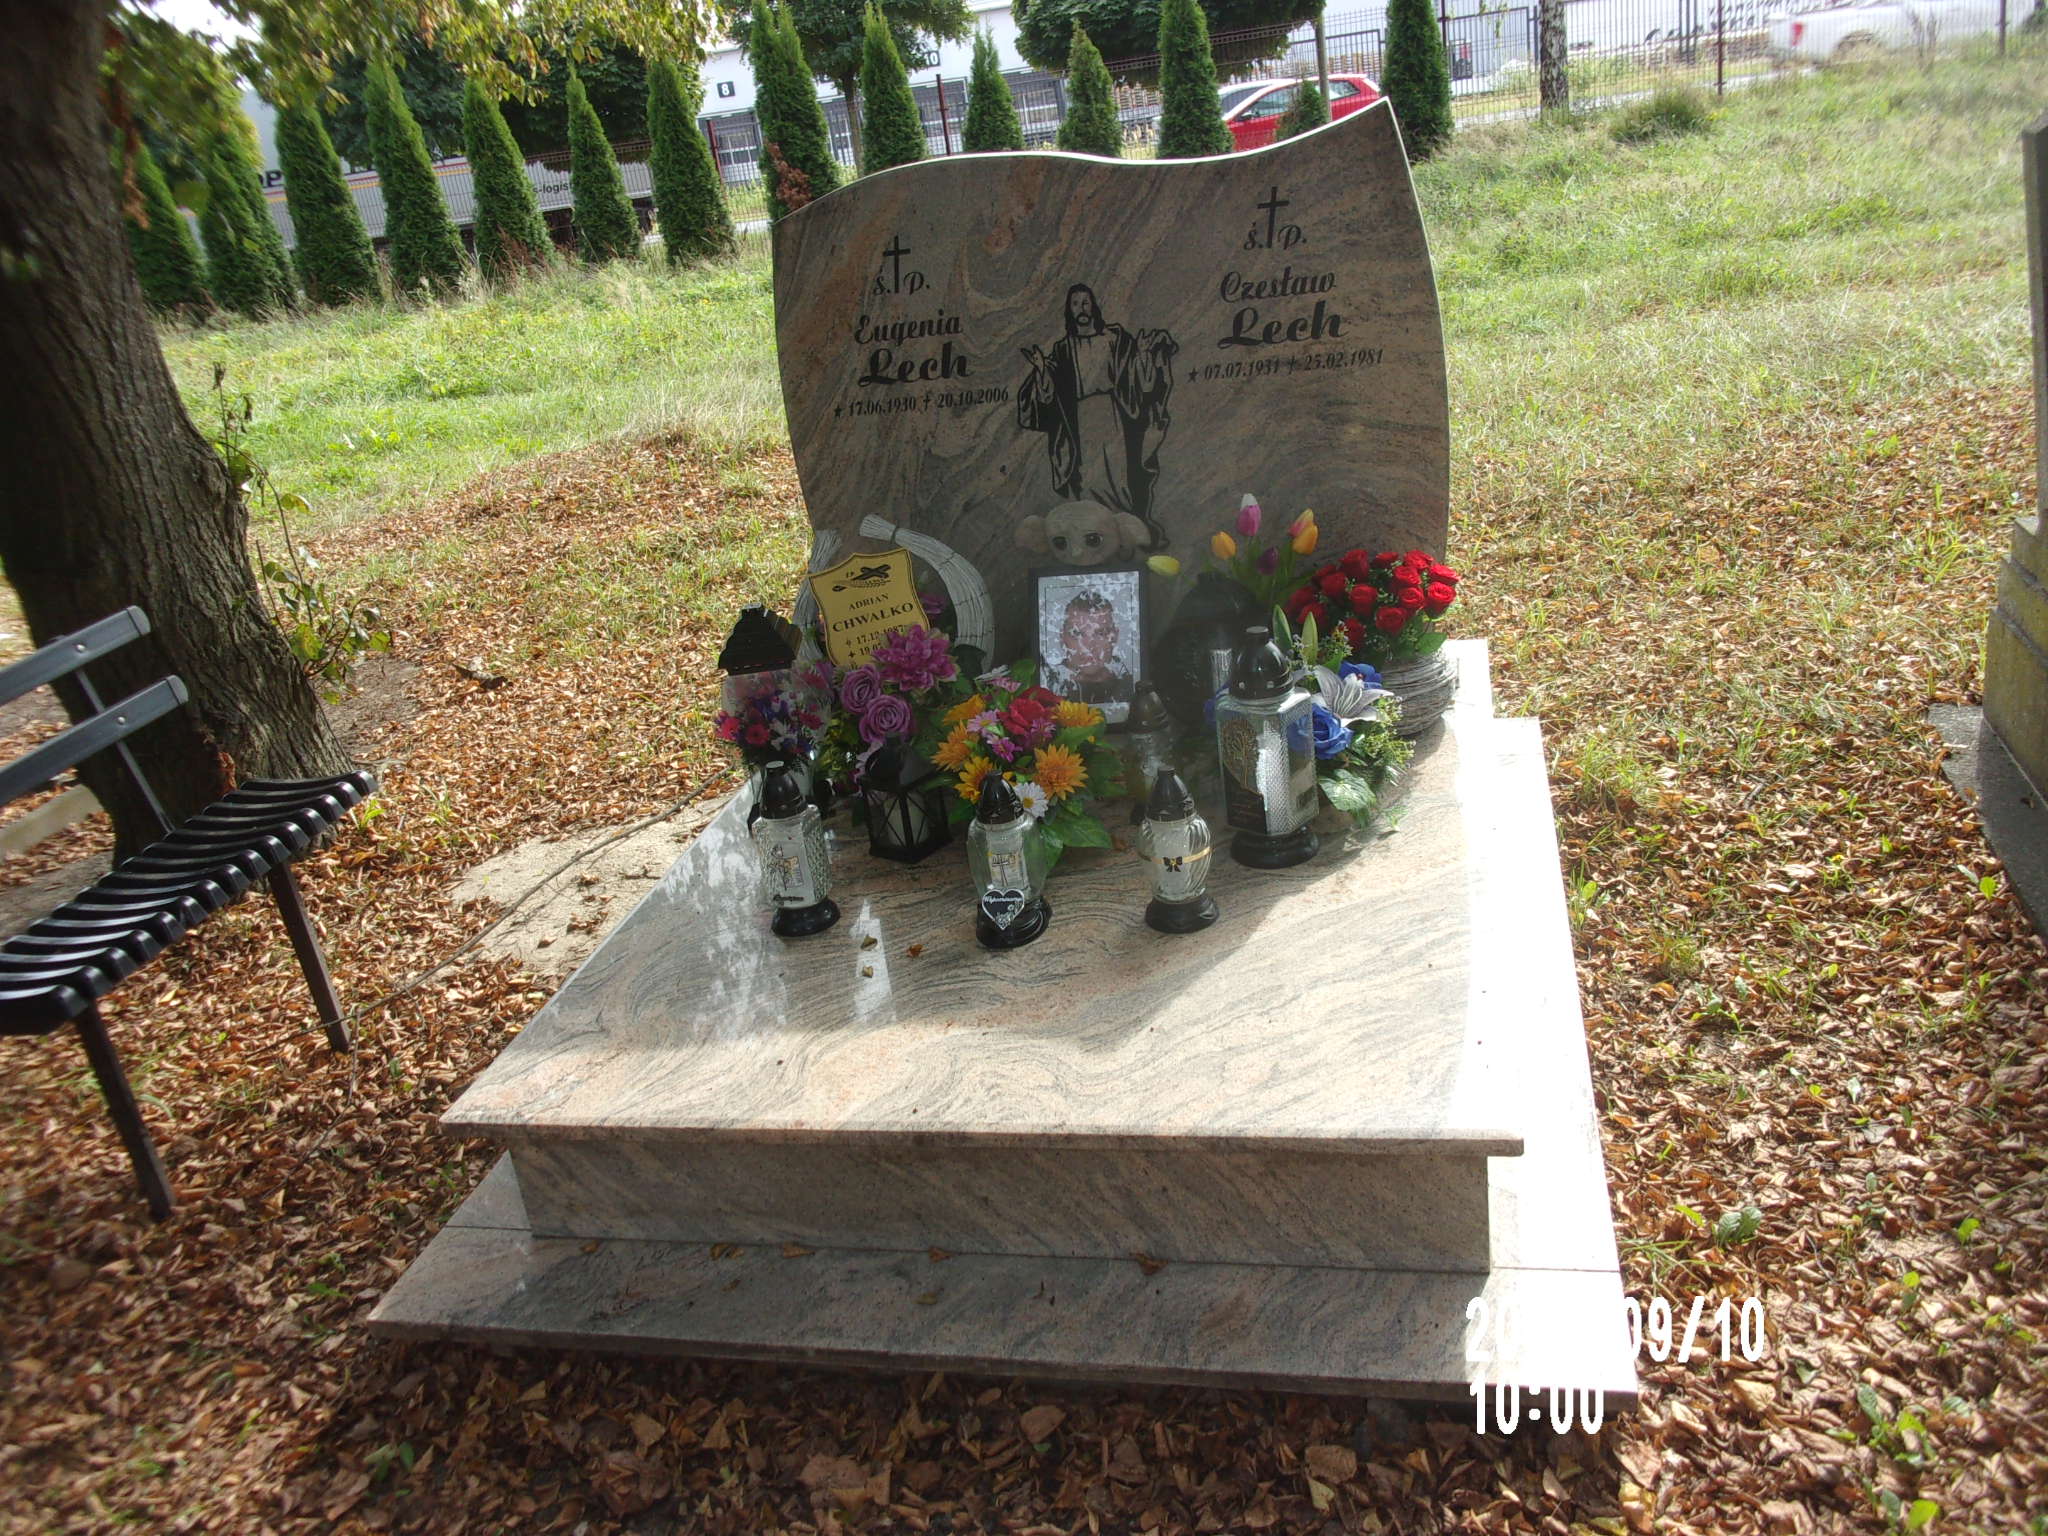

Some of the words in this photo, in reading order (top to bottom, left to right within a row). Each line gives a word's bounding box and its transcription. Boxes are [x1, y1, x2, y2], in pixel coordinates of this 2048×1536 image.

[721, 83, 730, 96] 8
[854, 309, 964, 346] Eugenia
[1216, 299, 1349, 350] Lech
[857, 341, 975, 388] Lech
[1303, 349, 1384, 371] 25.02.1981
[848, 396, 917, 416] 17.06.1930
[937, 387, 1009, 409] 20.10.2006
[848, 593, 889, 611] ADRIAN
